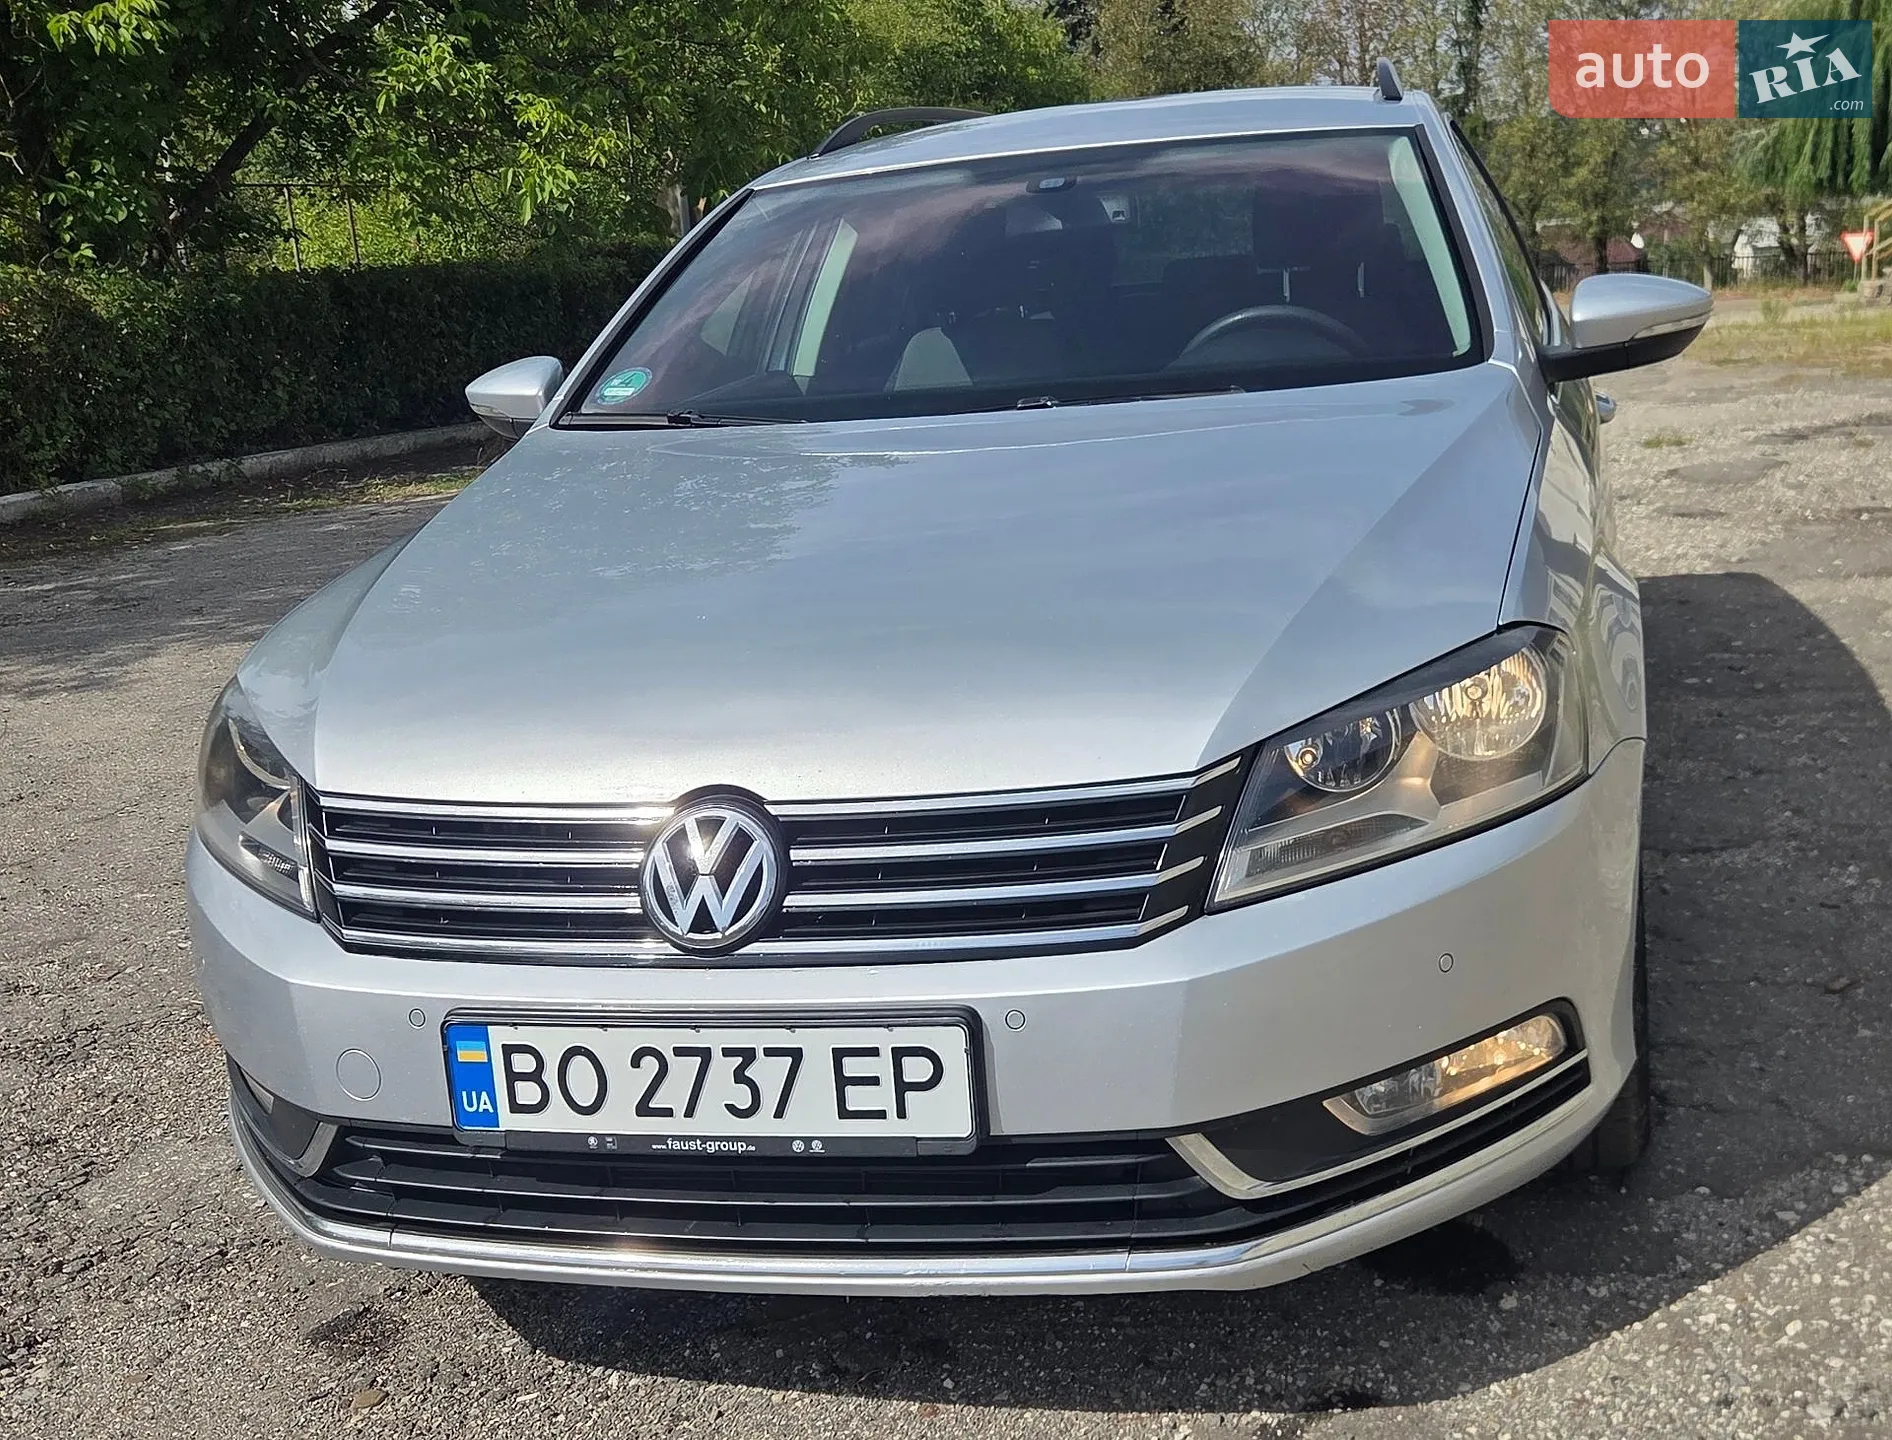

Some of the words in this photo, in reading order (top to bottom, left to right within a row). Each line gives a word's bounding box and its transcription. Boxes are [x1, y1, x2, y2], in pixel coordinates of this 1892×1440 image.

[461, 1090, 494, 1113] UA
[501, 1043, 608, 1116] BO
[630, 1046, 804, 1120] 2737
[831, 1046, 945, 1121] EP
